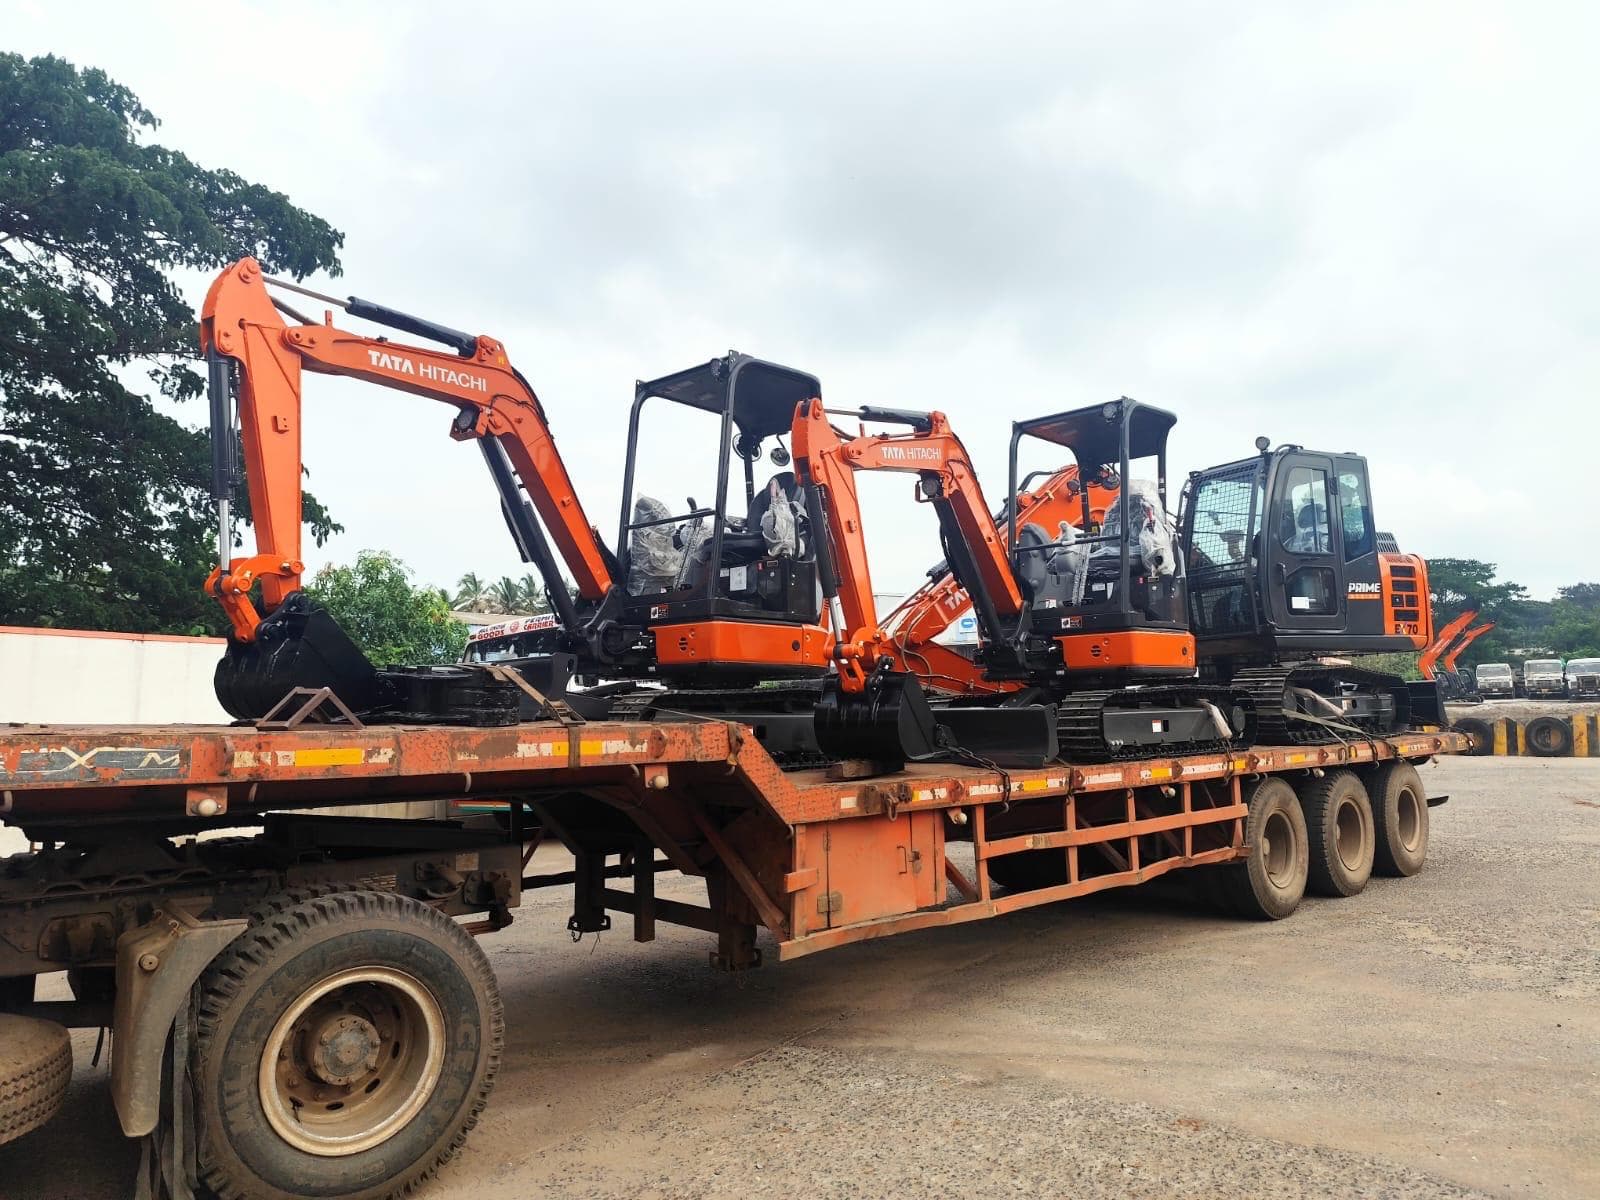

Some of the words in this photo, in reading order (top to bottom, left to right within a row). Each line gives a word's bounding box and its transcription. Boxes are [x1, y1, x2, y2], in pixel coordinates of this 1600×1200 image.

[367, 349, 415, 375] TATA
[419, 362, 487, 392] HITACHI
[881, 446, 906, 460] TATA
[906, 447, 942, 460] HITACHI
[1348, 582, 1382, 593] PRIME
[477, 629, 505, 641] GOODS
